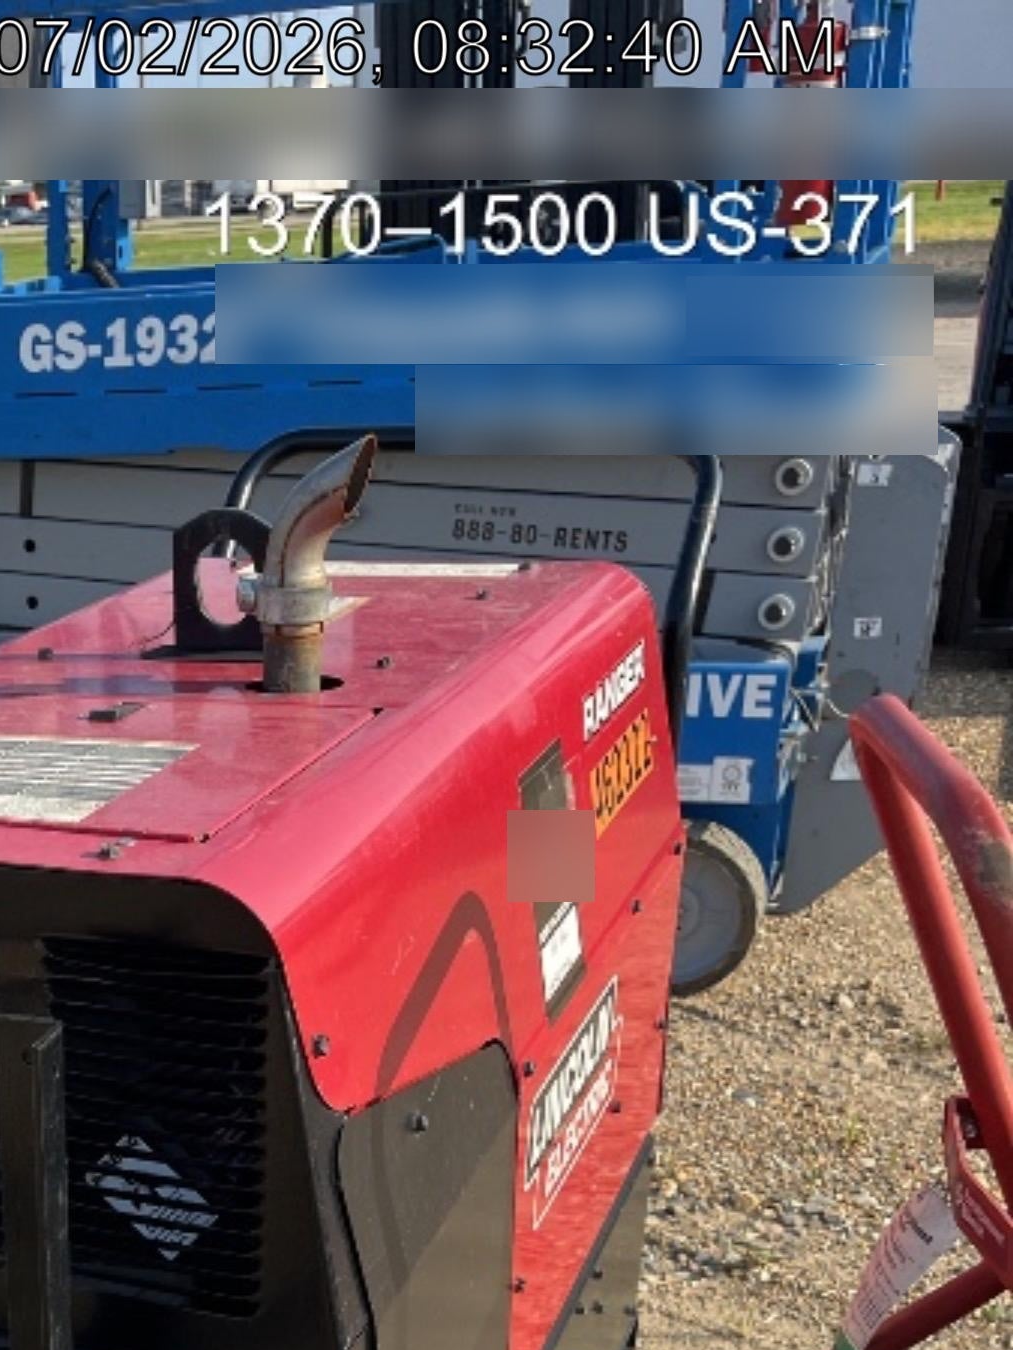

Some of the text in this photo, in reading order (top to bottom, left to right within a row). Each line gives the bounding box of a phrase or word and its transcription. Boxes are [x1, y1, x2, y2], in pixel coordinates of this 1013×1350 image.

[452, 518, 628, 552] 888-80-RENTS
[583, 638, 646, 742] RANGER
[683, 672, 777, 719] IVE
[530, 993, 615, 1168] LINCOLN
